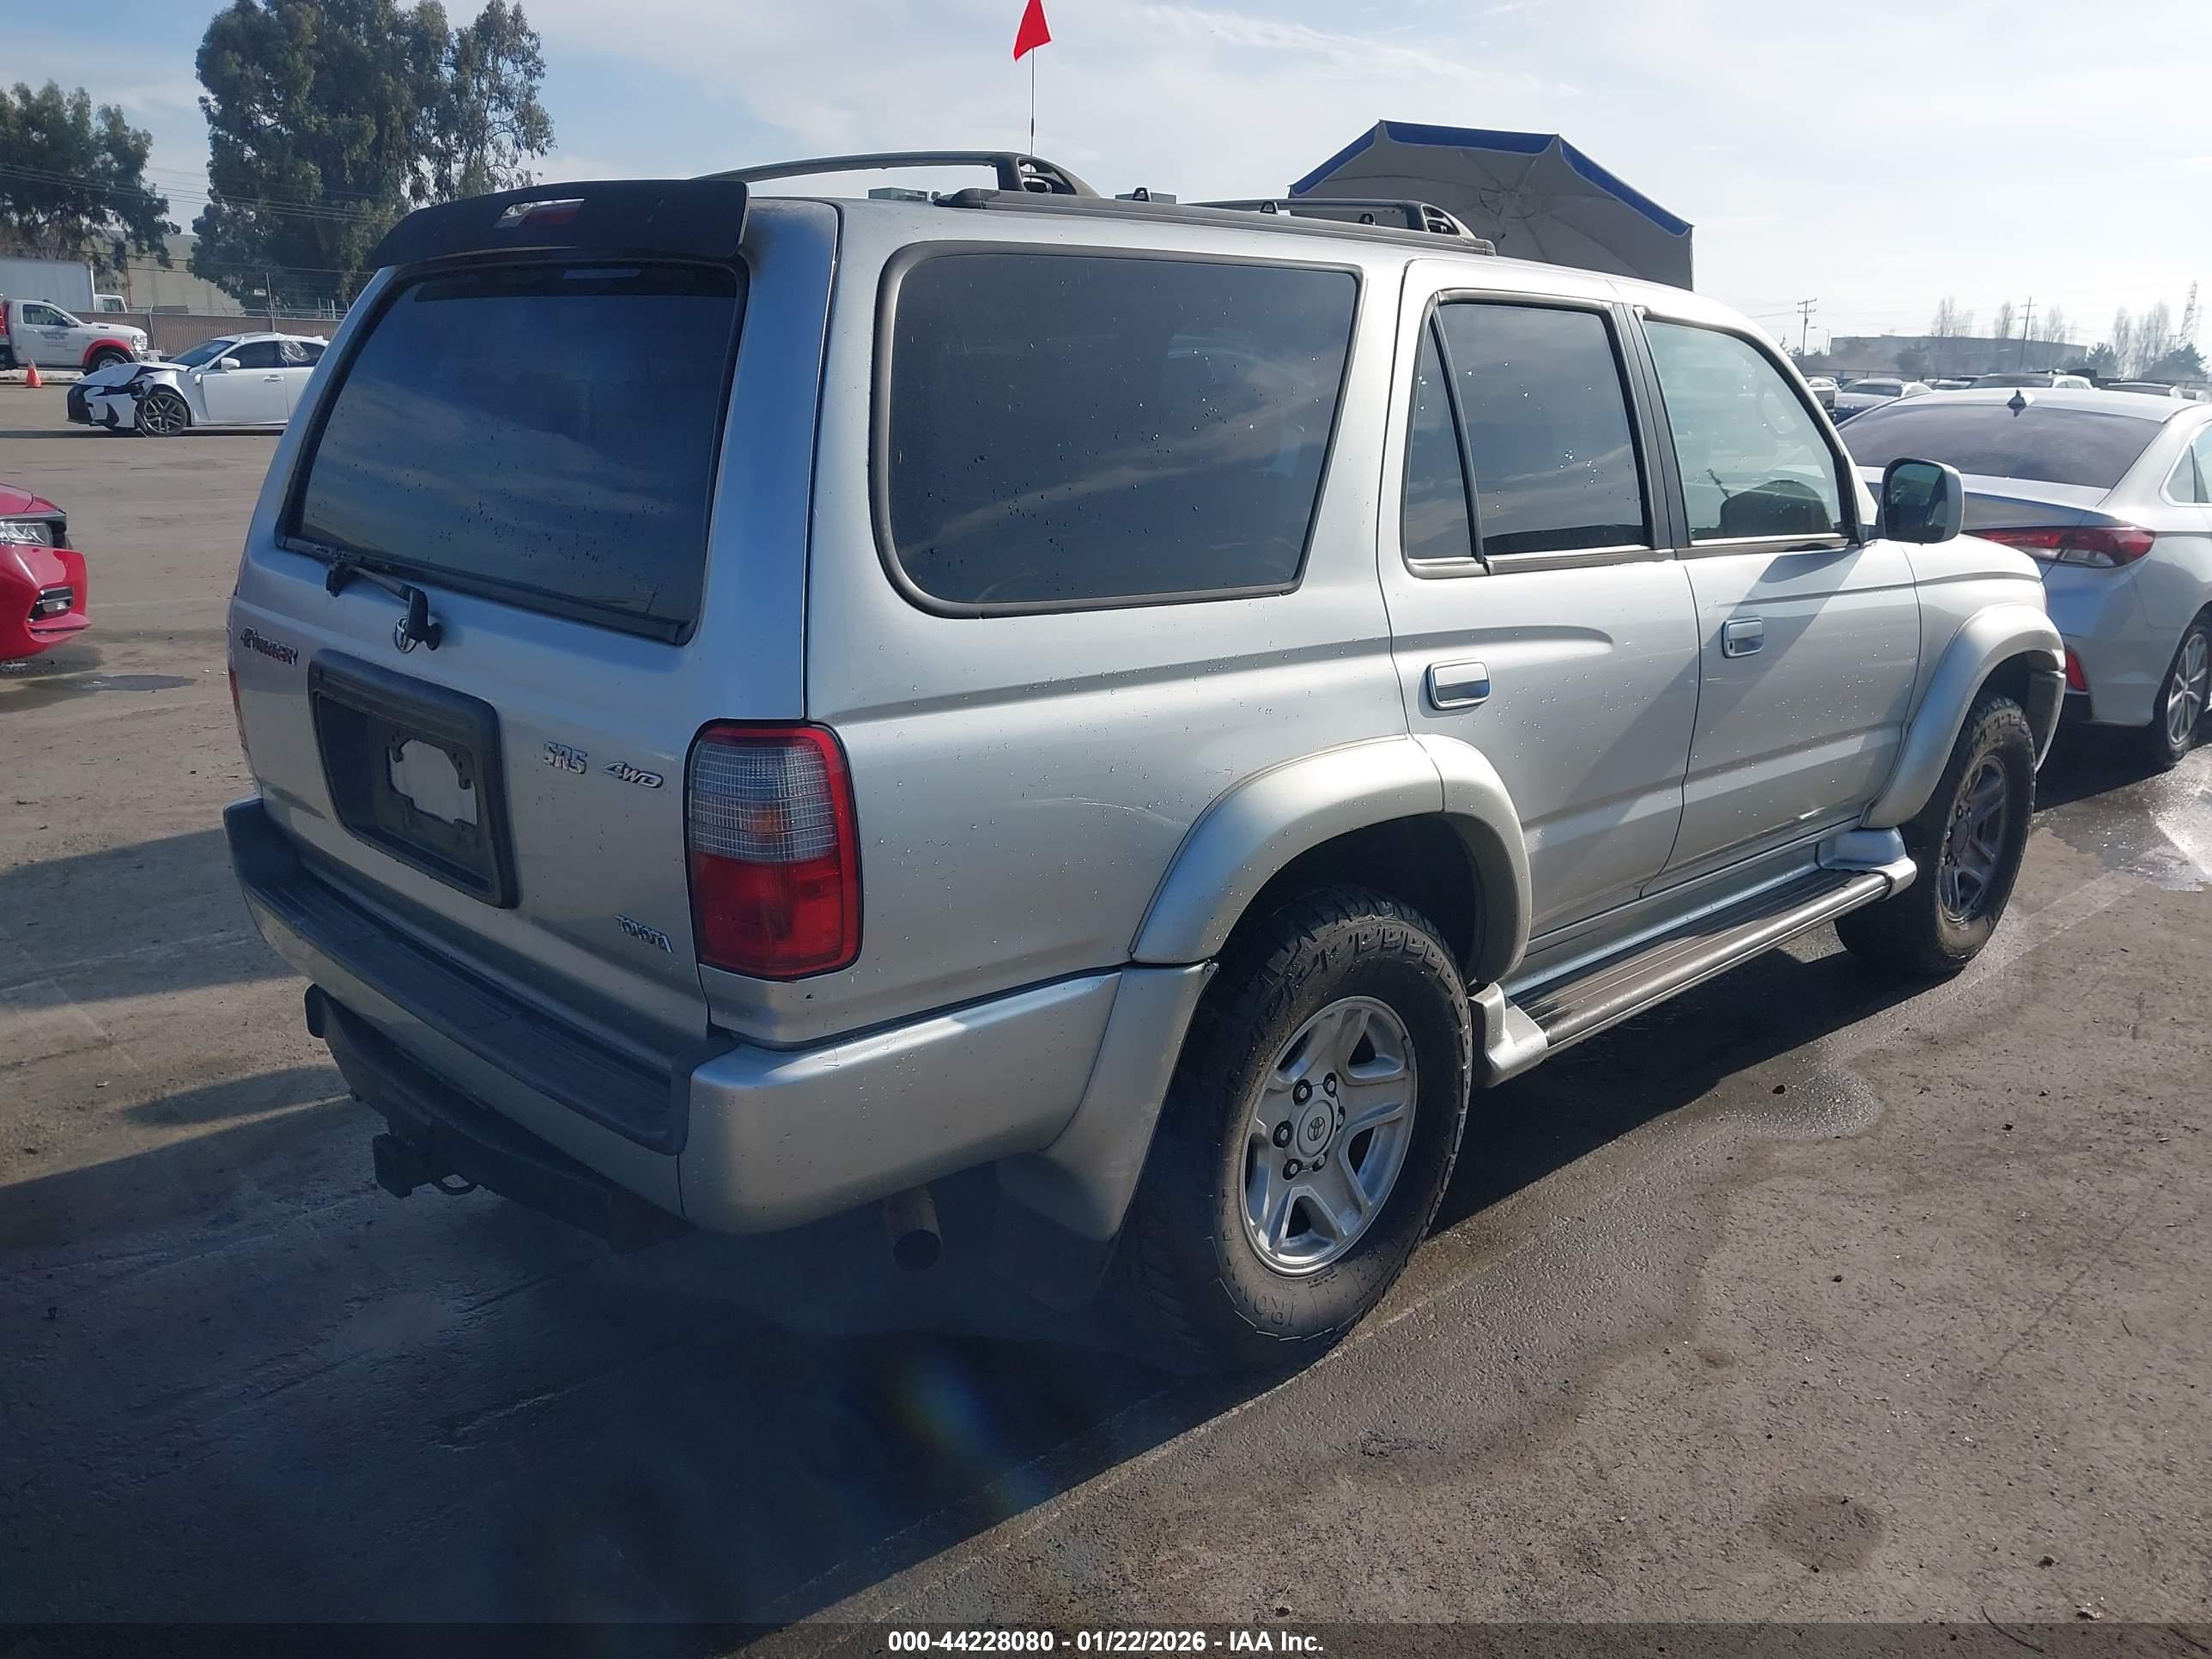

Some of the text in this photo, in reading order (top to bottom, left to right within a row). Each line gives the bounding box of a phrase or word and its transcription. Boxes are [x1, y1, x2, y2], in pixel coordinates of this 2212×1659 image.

[544, 741, 664, 788] SR5 4WD
[614, 915, 673, 953] TOYOTA
